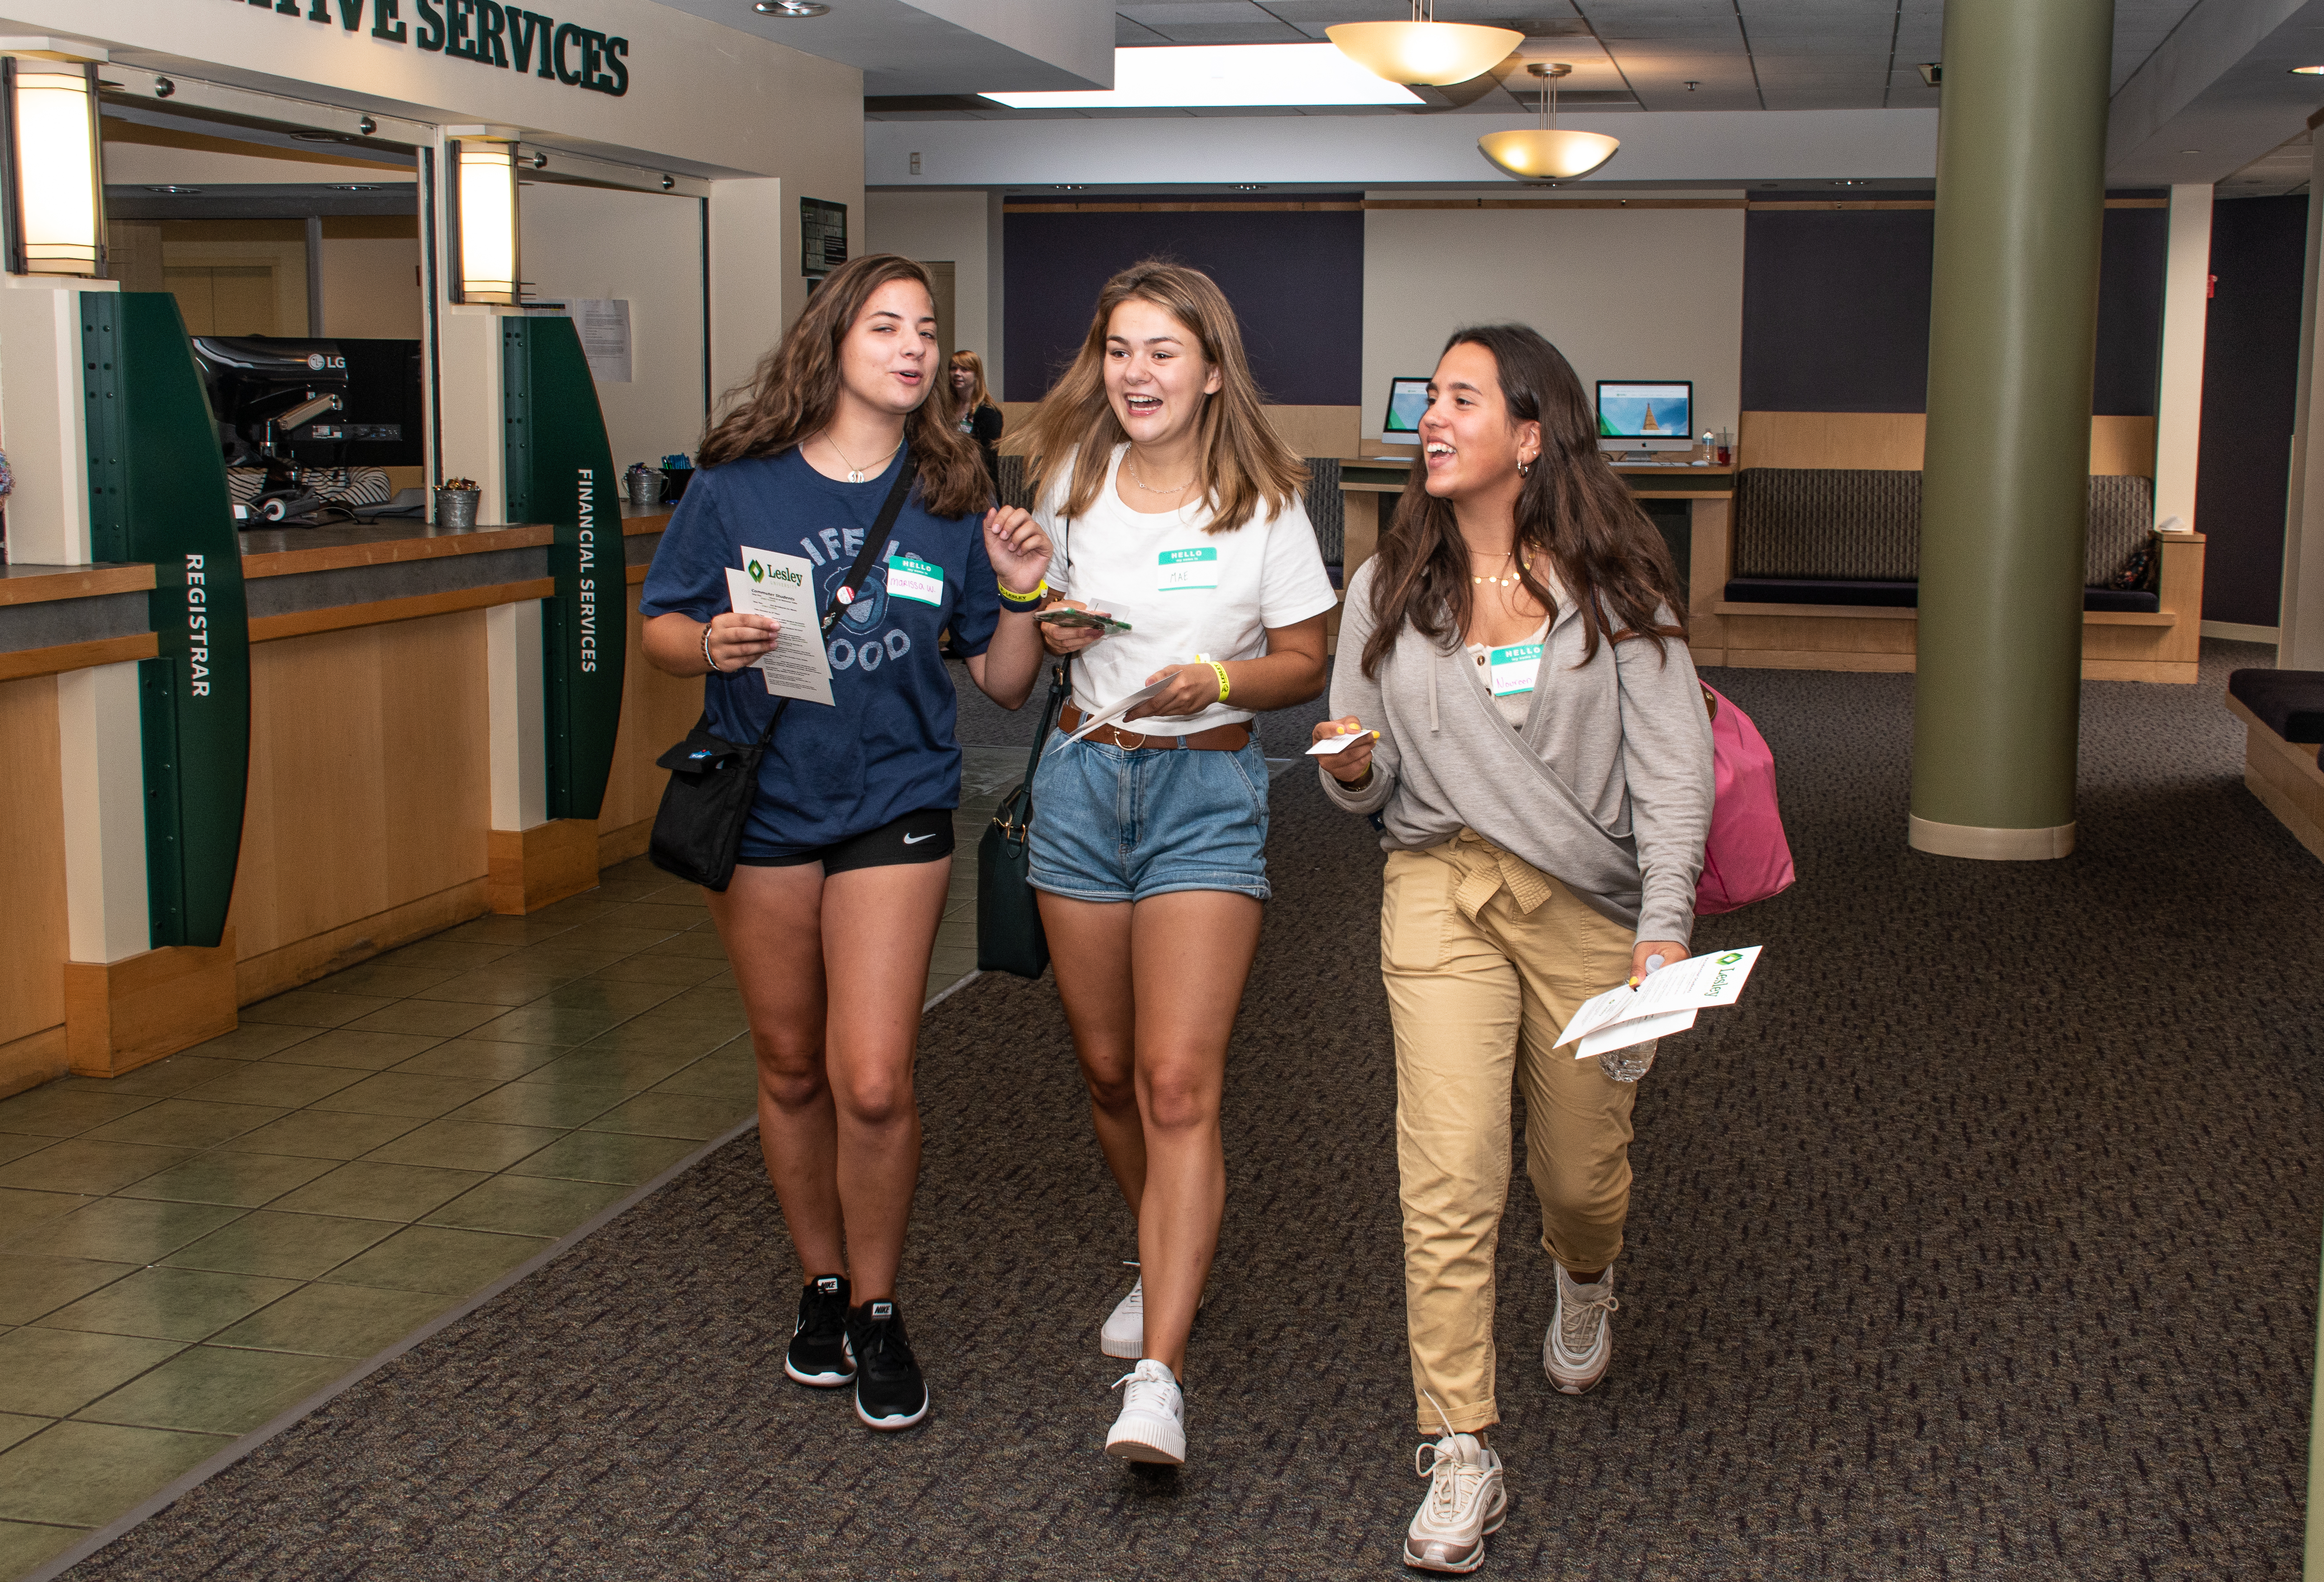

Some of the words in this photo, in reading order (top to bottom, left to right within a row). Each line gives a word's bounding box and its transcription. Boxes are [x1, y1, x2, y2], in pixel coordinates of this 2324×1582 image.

[417, 0, 629, 97] SERVICES
[327, 357, 346, 368] LG
[578, 469, 594, 573] FINANCIAL
[800, 527, 864, 571] IFE
[1171, 550, 1202, 559] HELLO
[903, 560, 931, 571] HELLO
[767, 564, 803, 587] Lesley
[1170, 571, 1189, 583] MAE
[770, 581, 797, 589] UNIVERSITY
[752, 589, 775, 597] Commuter
[1006, 591, 1027, 600] LESLEY
[185, 554, 210, 696] REGISTRAR
[580, 579, 597, 673] SERVICES
[827, 629, 910, 671] OOD
[1505, 647, 1540, 657] HELLO
[1214, 664, 1226, 684] LESLEY
[1704, 967, 1735, 996] Lesley
[821, 1281, 836, 1289] NIKE
[874, 1305, 890, 1314] NIKE
